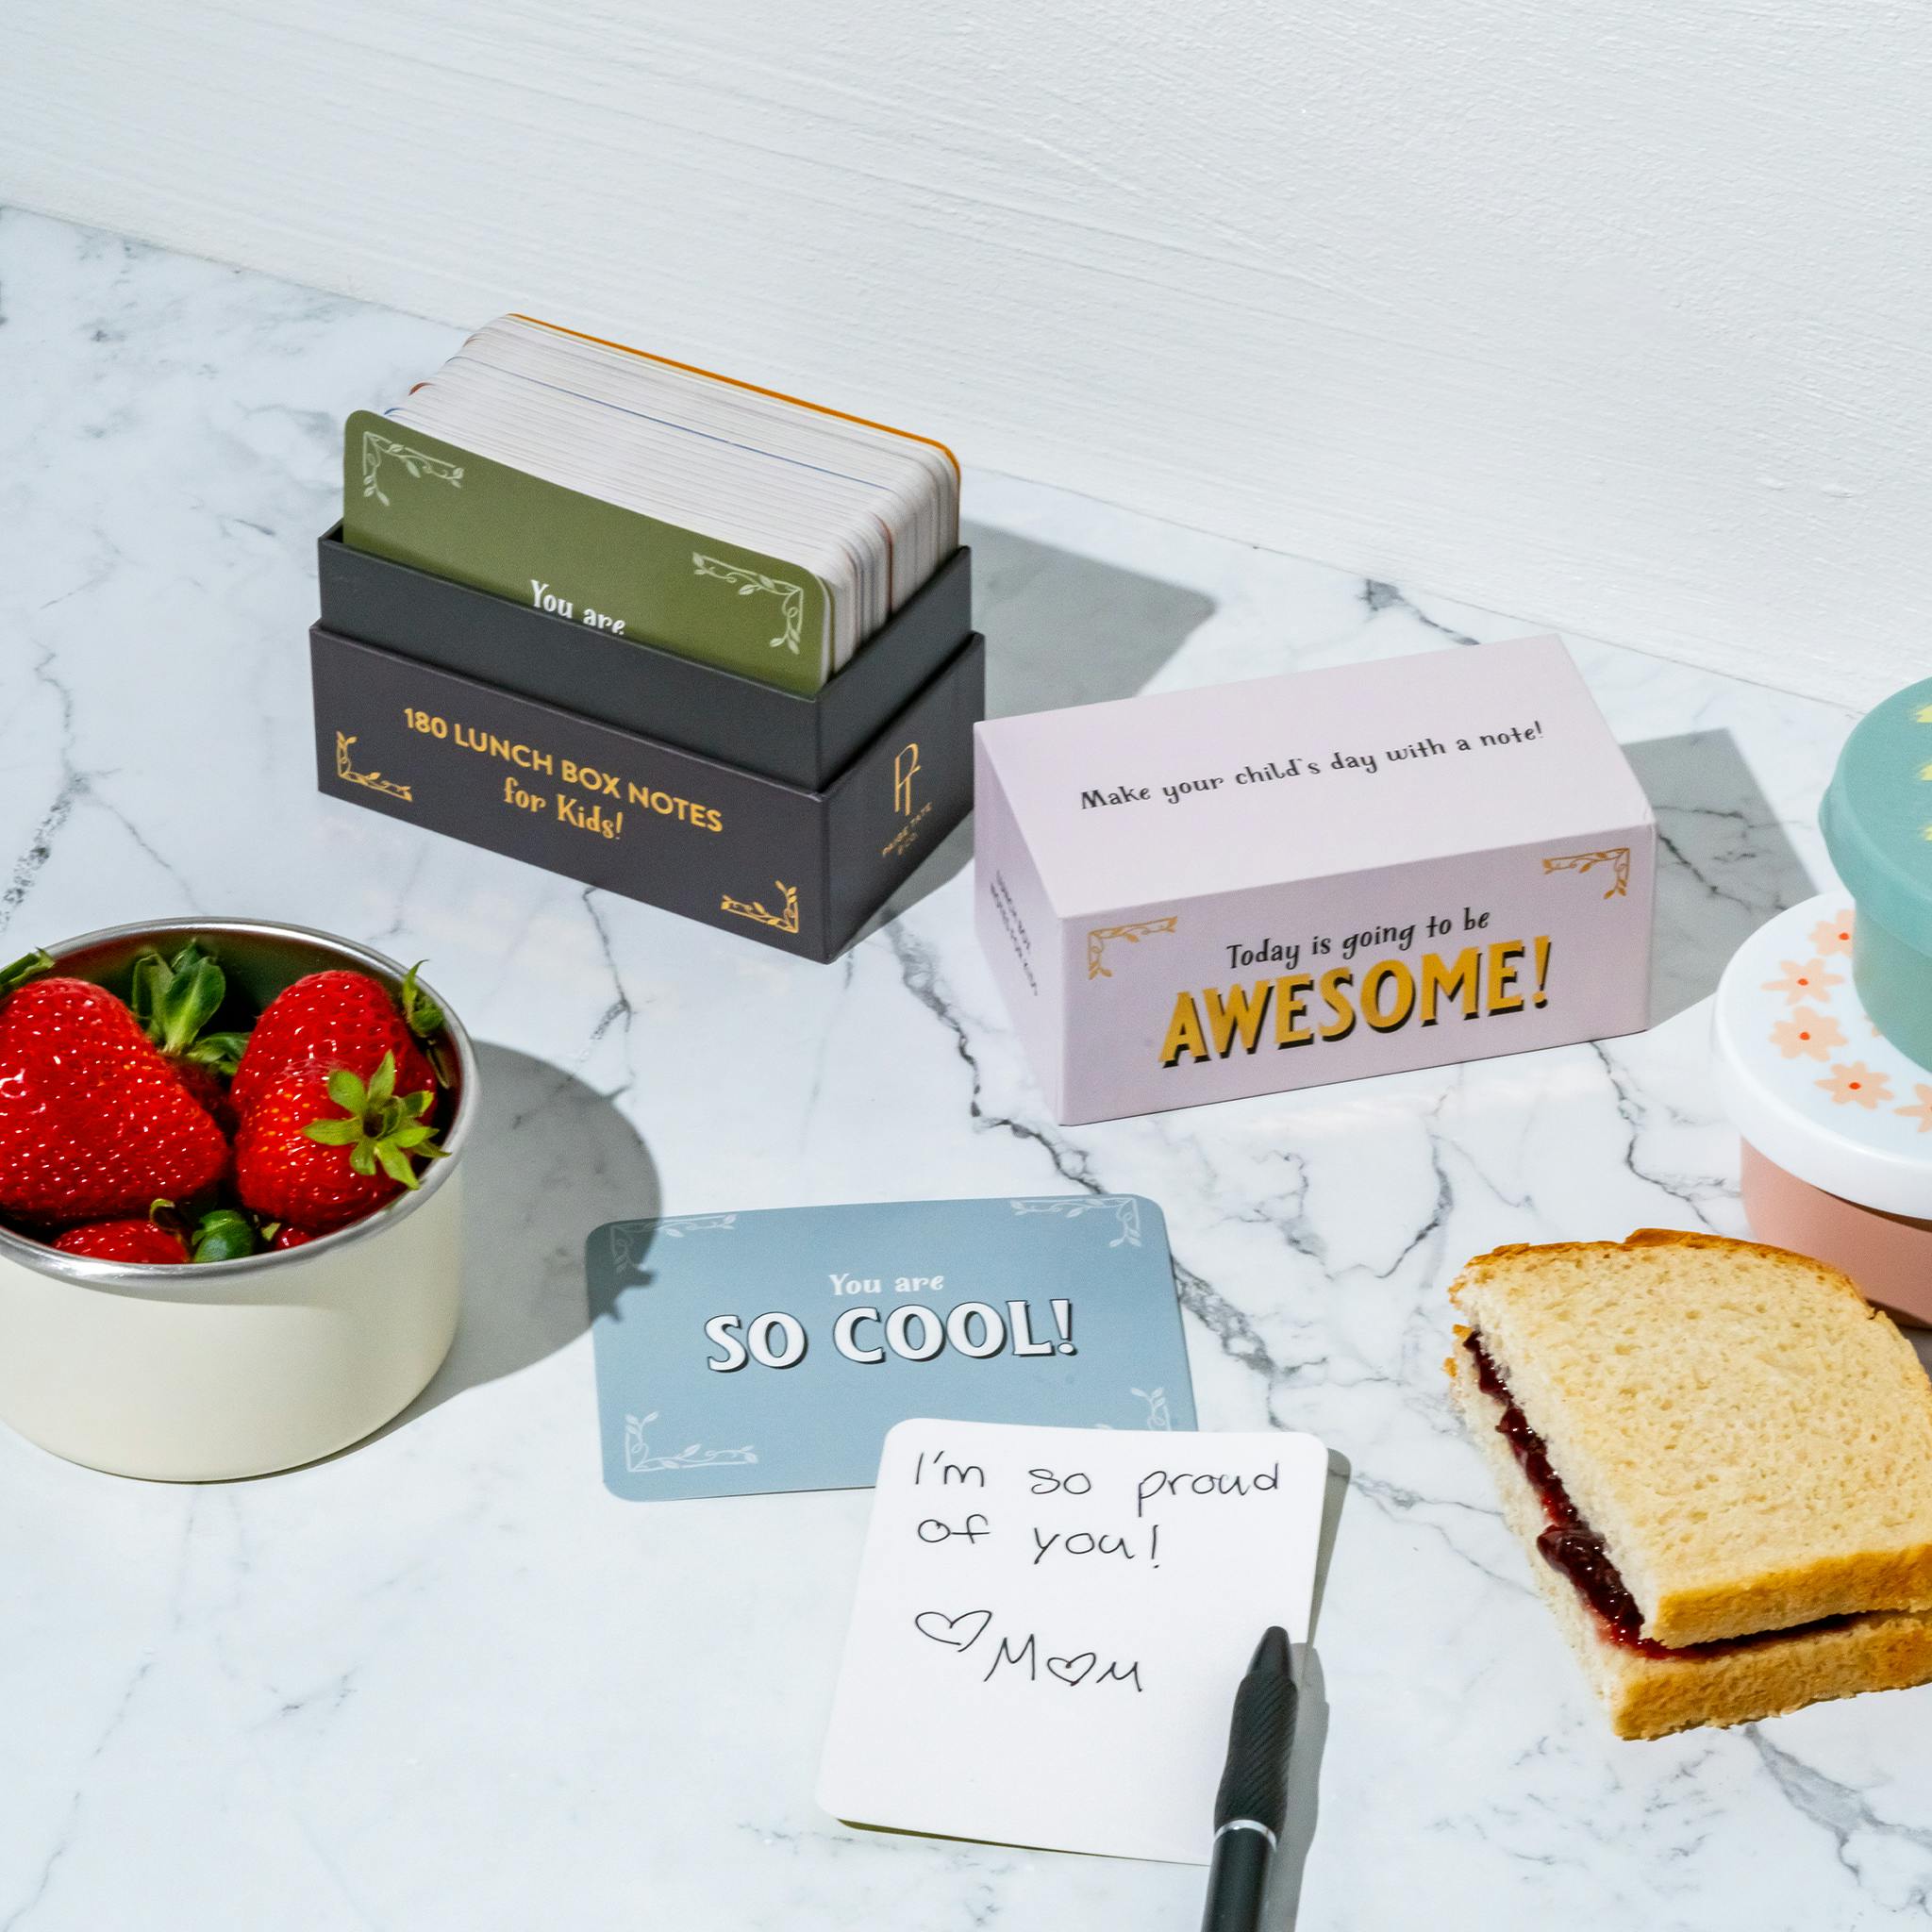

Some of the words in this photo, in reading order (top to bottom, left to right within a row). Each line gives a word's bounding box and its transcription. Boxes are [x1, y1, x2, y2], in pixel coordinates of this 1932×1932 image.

[530, 579, 574, 619] You
[583, 608, 625, 635] are
[404, 708, 448, 740] 180
[454, 724, 553, 775] LUNCH
[561, 759, 622, 799] BOX
[628, 782, 724, 832] NOTES
[1080, 786, 1151, 809] Make
[1162, 776, 1224, 805] your
[1235, 758, 1321, 785] child's
[1330, 752, 1377, 774] day
[1386, 739, 1447, 761] with
[1456, 739, 1471, 751] a
[1479, 721, 1543, 746] note!
[504, 776, 547, 813] for
[557, 793, 624, 840] Kids!
[1226, 938, 1300, 970] Today
[1312, 935, 1331, 956] is
[1342, 924, 1416, 959] going
[1425, 915, 1452, 938] to
[1463, 907, 1490, 931] be
[1158, 935, 1552, 1069] AWESOME!
[828, 1273, 882, 1295] You
[894, 1274, 944, 1292] are
[704, 1311, 808, 1374] SO
[833, 1299, 1077, 1364] COOL!
[915, 1451, 984, 1488] I'm
[1028, 1469, 1091, 1494] so
[1138, 1463, 1279, 1517] proud
[918, 1514, 991, 1543] of
[1034, 1524, 1159, 1568] you!
